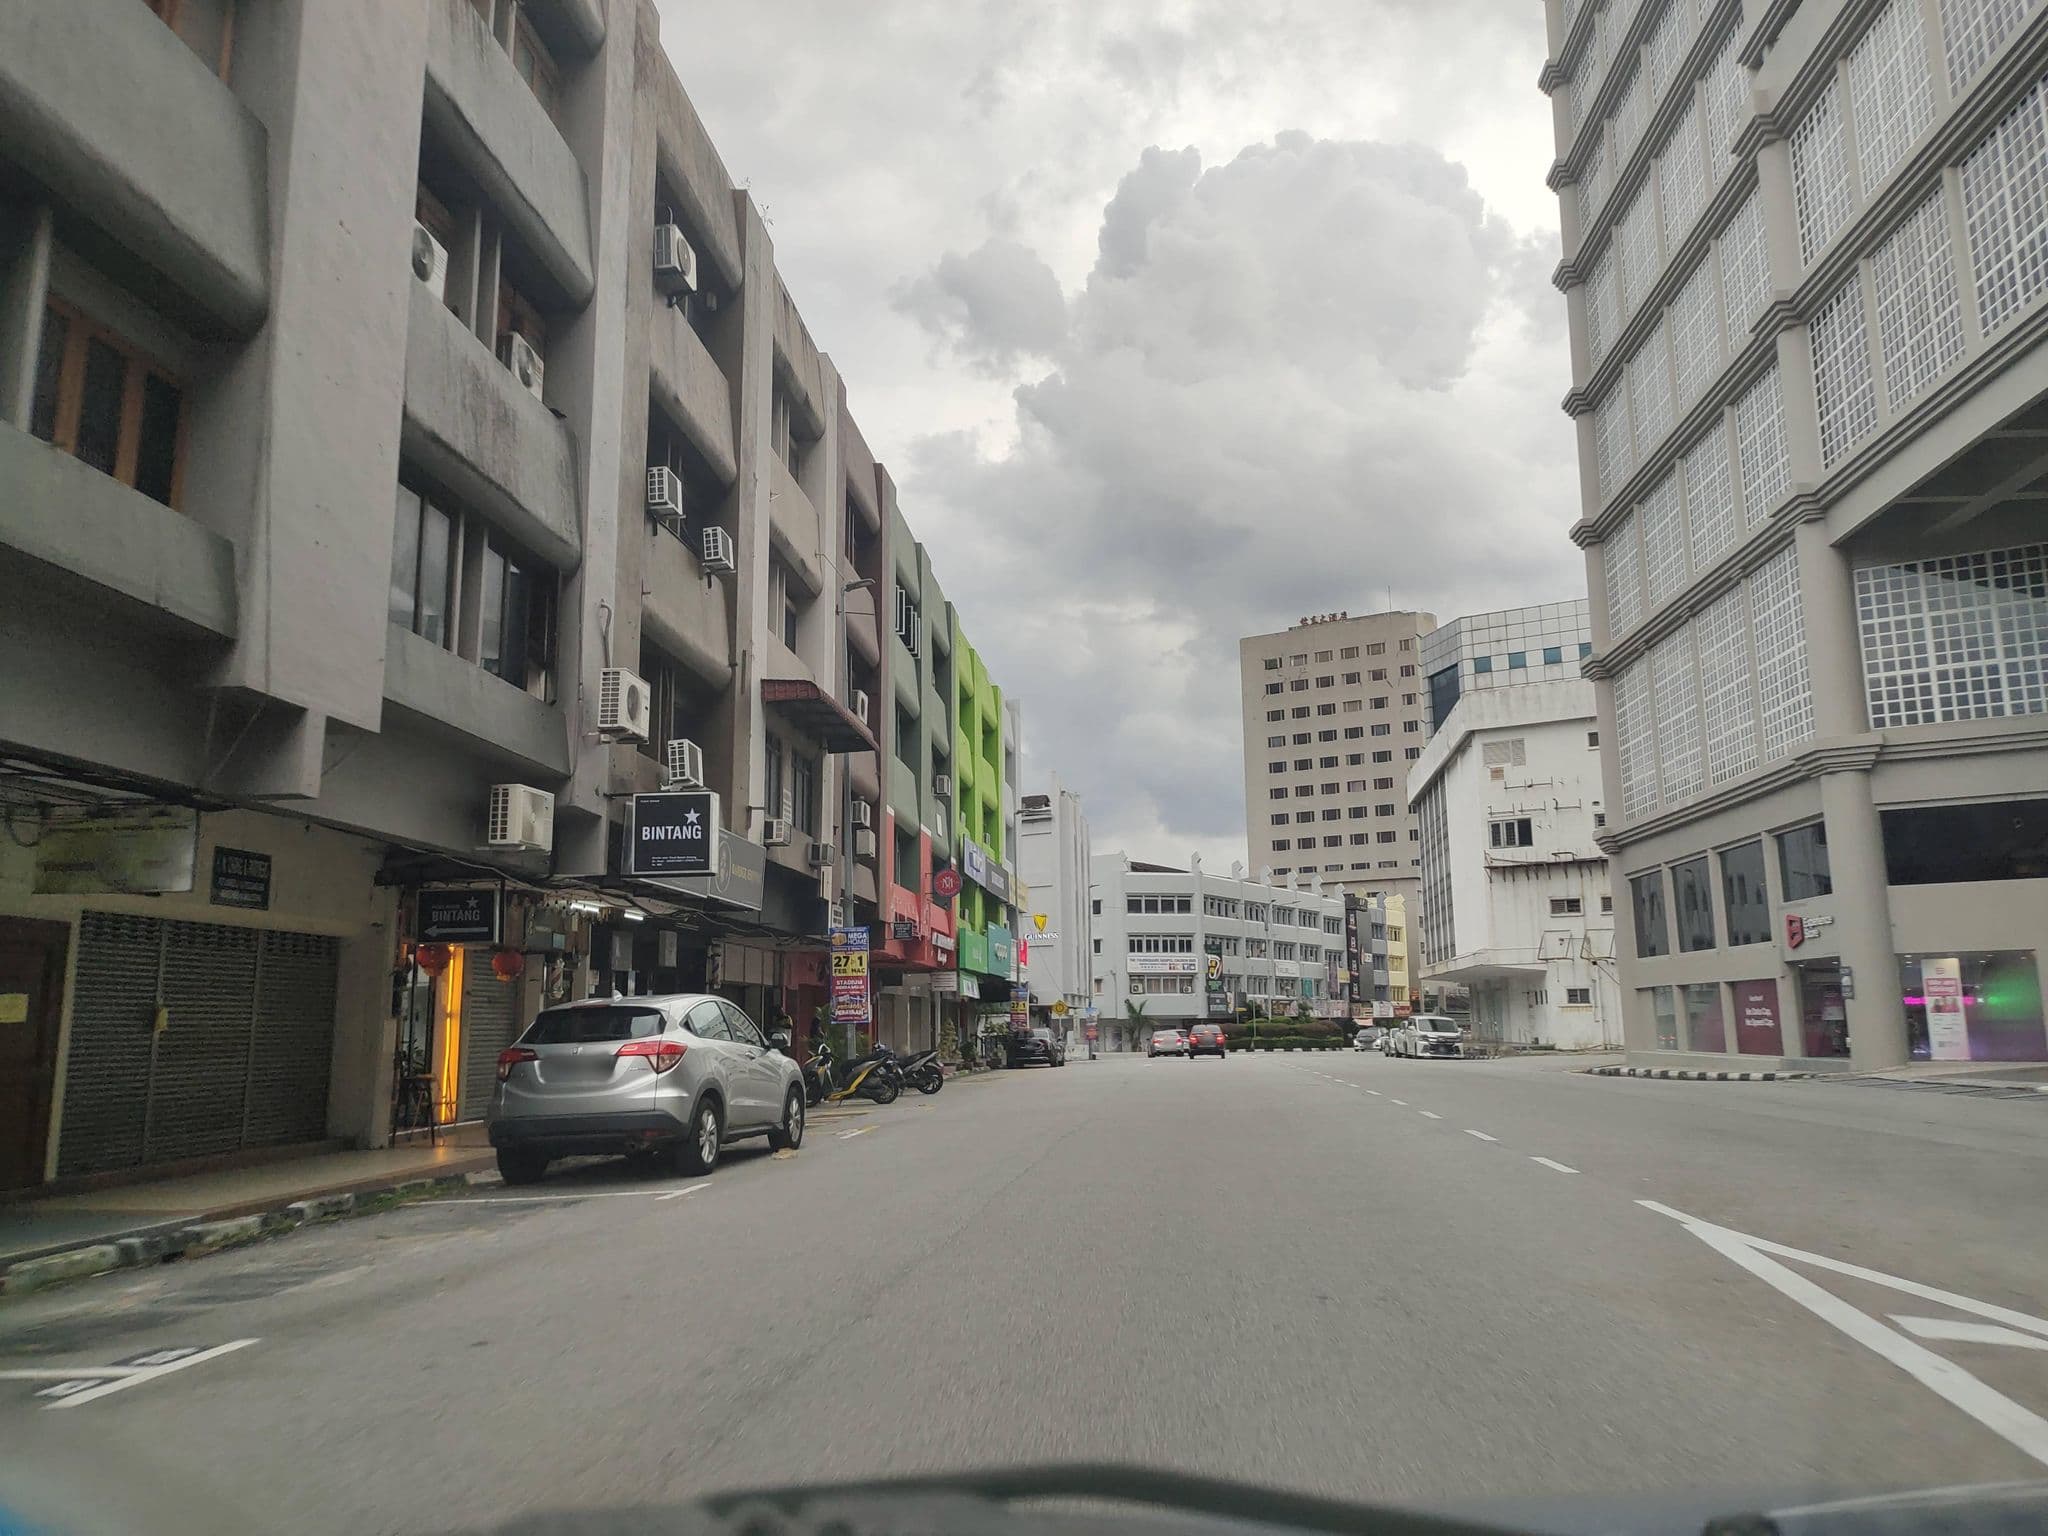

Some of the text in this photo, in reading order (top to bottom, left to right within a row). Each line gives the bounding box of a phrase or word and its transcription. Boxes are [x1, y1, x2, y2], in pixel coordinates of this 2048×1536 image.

[642, 825, 702, 840] BINTANG
[432, 908, 480, 922] BINTANG
[1024, 931, 1059, 941] GUINNESS
[833, 955, 863, 968] 27 1
